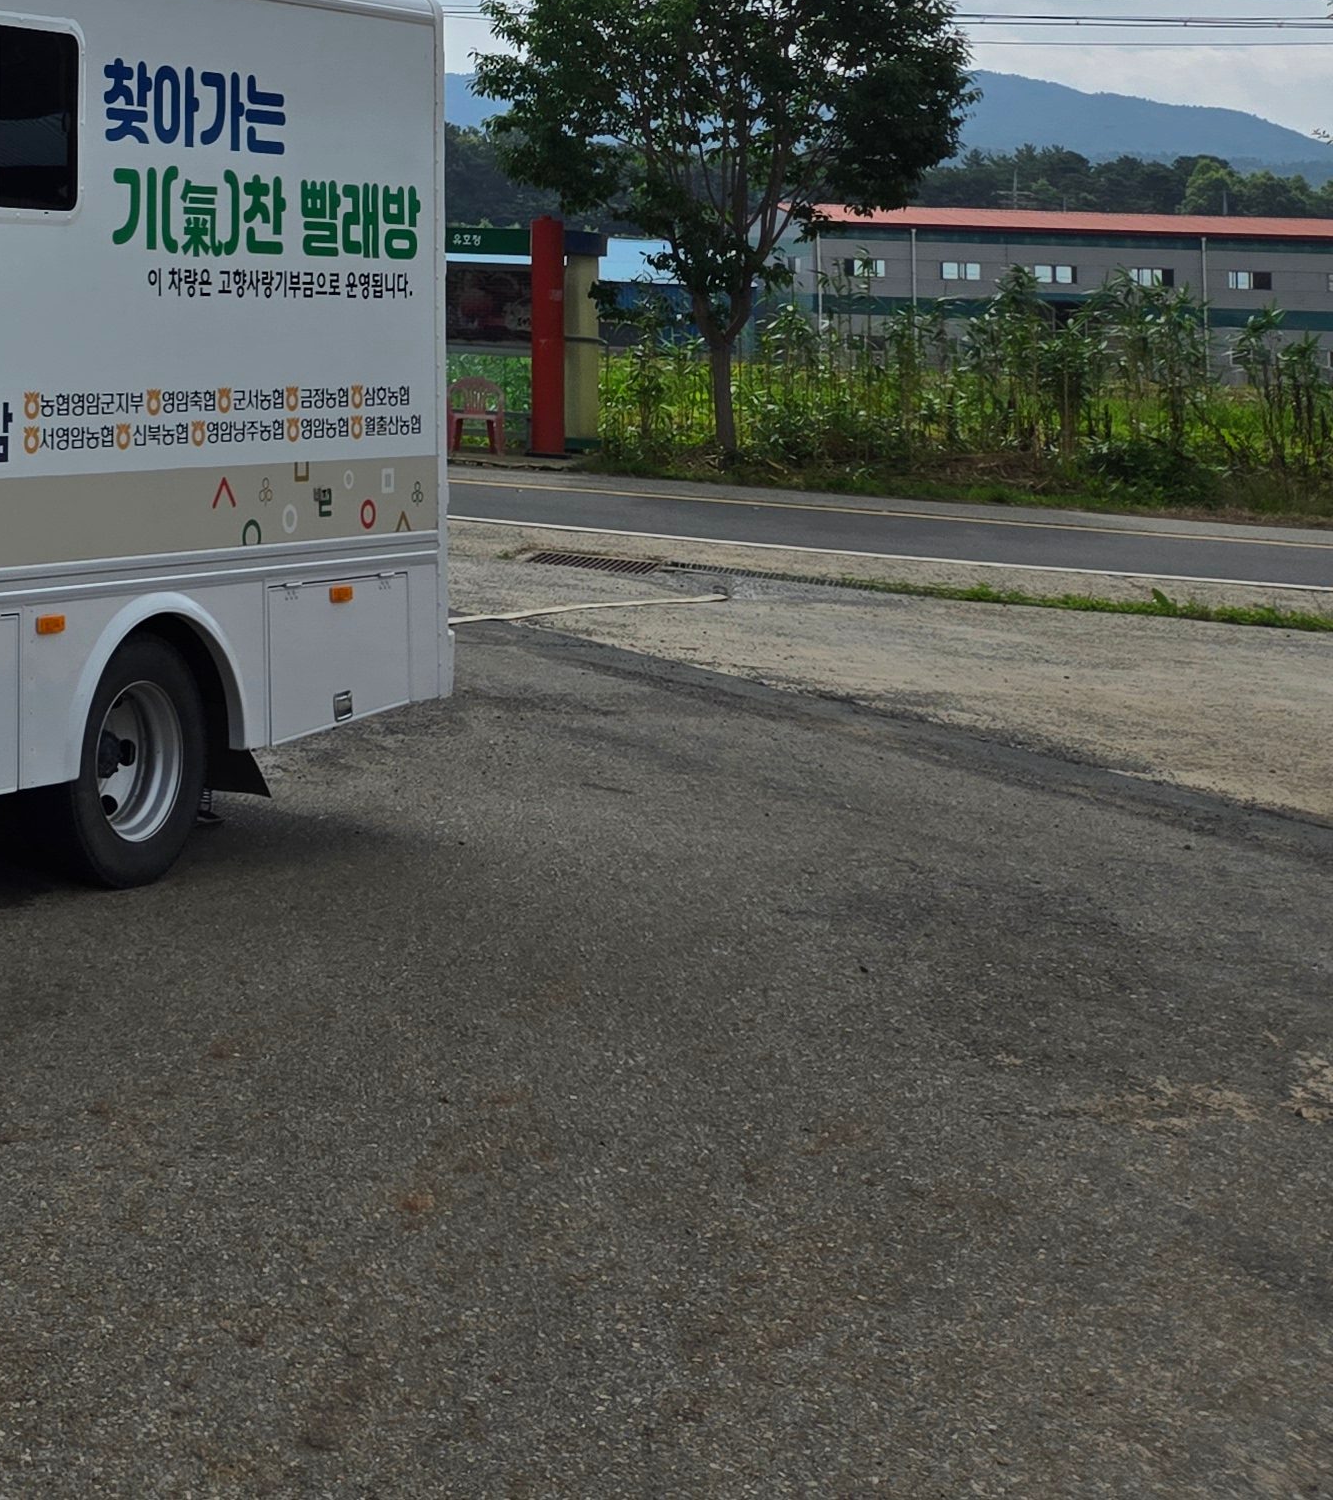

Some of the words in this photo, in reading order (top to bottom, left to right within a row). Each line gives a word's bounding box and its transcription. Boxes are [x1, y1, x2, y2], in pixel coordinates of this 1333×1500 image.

[103, 57, 286, 155] 찾아가는
[112, 165, 287, 258] 기(氣)찬
[301, 179, 422, 261] 빨래방
[147, 268, 162, 297] 이
[168, 268, 213, 299] 차량은
[218, 268, 342, 299] 고향사랑기부금으로
[346, 271, 414, 300] 운영됩니다.
[40, 393, 144, 418] 농협영암군지부
[162, 390, 216, 414] 영암축협
[233, 387, 284, 411] 군서농협
[300, 386, 349, 409] 금정농협
[364, 385, 410, 407] 삼호농협
[39, 425, 114, 451] 서영암농협
[133, 422, 189, 447] 신북농협
[206, 419, 284, 443] 영암낭주농협
[300, 417, 349, 440] 영암농협
[364, 414, 421, 436] 월출산농협
